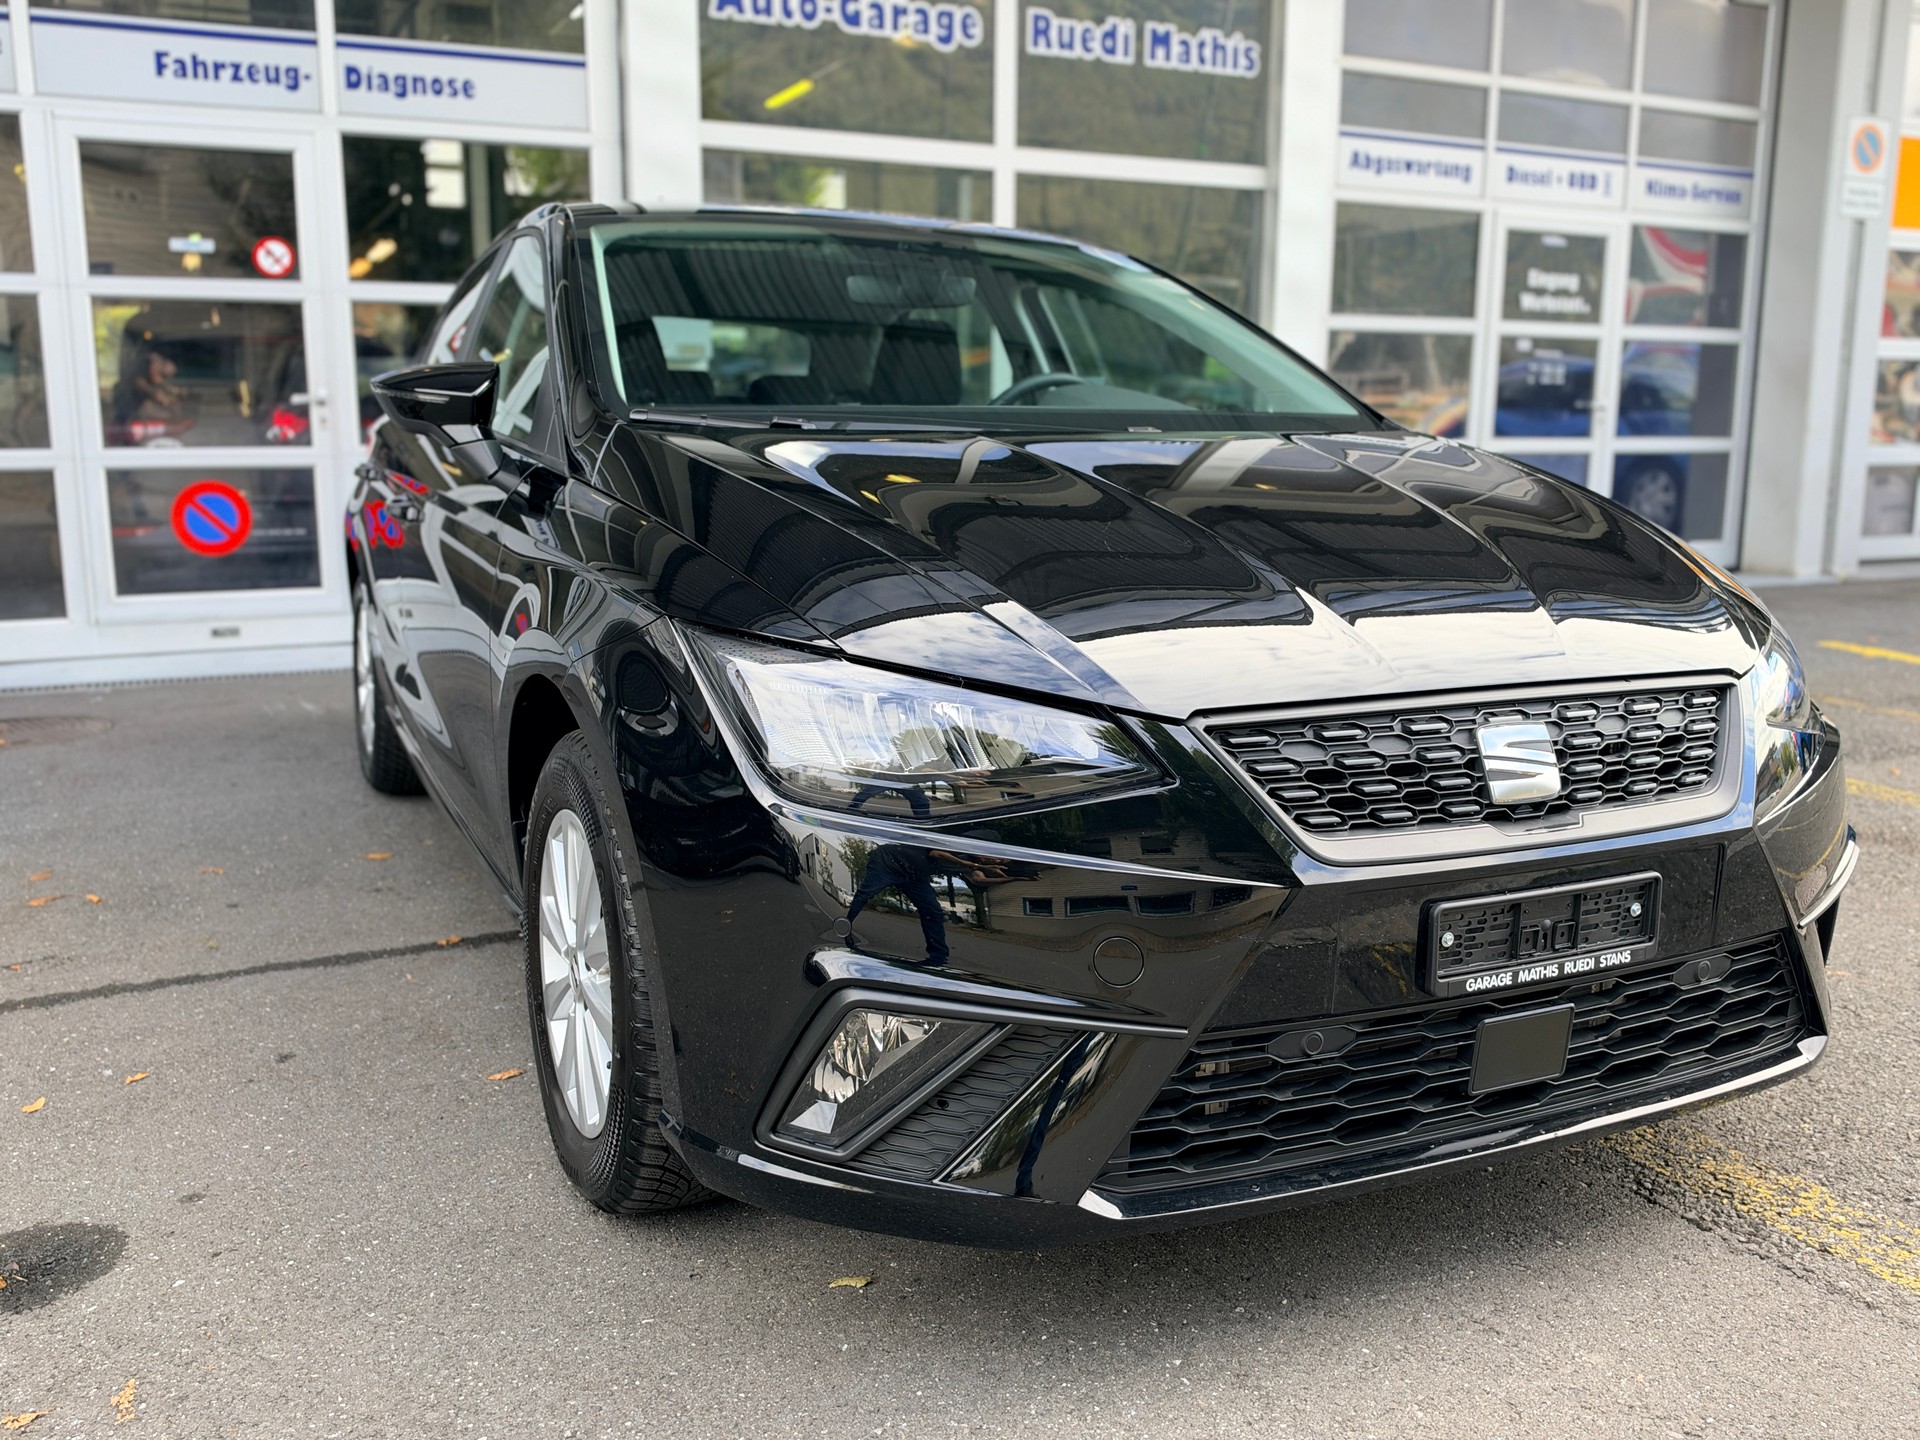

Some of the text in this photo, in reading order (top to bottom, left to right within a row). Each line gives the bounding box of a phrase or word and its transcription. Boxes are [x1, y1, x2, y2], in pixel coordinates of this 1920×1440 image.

[1029, 11, 1133, 61] Ruedi
[1147, 24, 1258, 74] Mathis
[154, 50, 475, 99] Fahrzeug- Diagnose
[1465, 950, 1632, 992] GARAGE MATHIS RUEDI STANS
